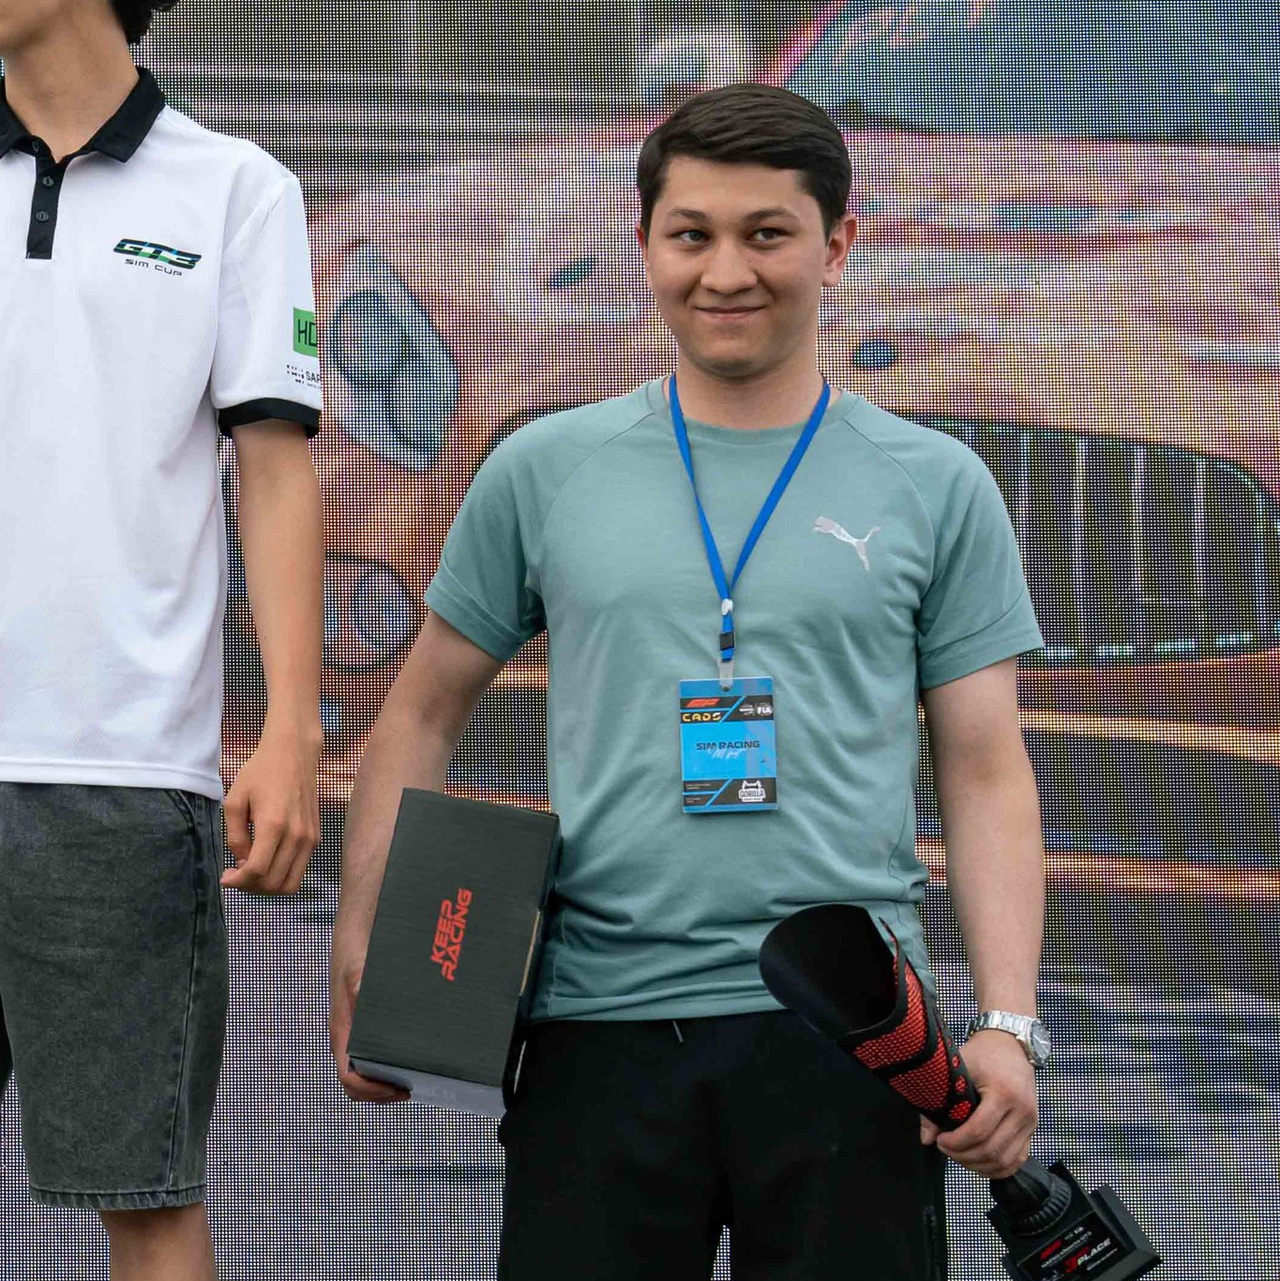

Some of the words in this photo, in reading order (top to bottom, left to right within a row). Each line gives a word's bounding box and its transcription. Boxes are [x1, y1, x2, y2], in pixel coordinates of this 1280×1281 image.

[124, 258, 149, 268] SIM
[154, 263, 183, 276] CUP
[696, 741, 717, 751] SIM
[718, 740, 760, 750] RACING
[430, 900, 452, 964] KEEP
[441, 888, 473, 981] RACING
[1075, 1237, 1111, 1265] PLACE
